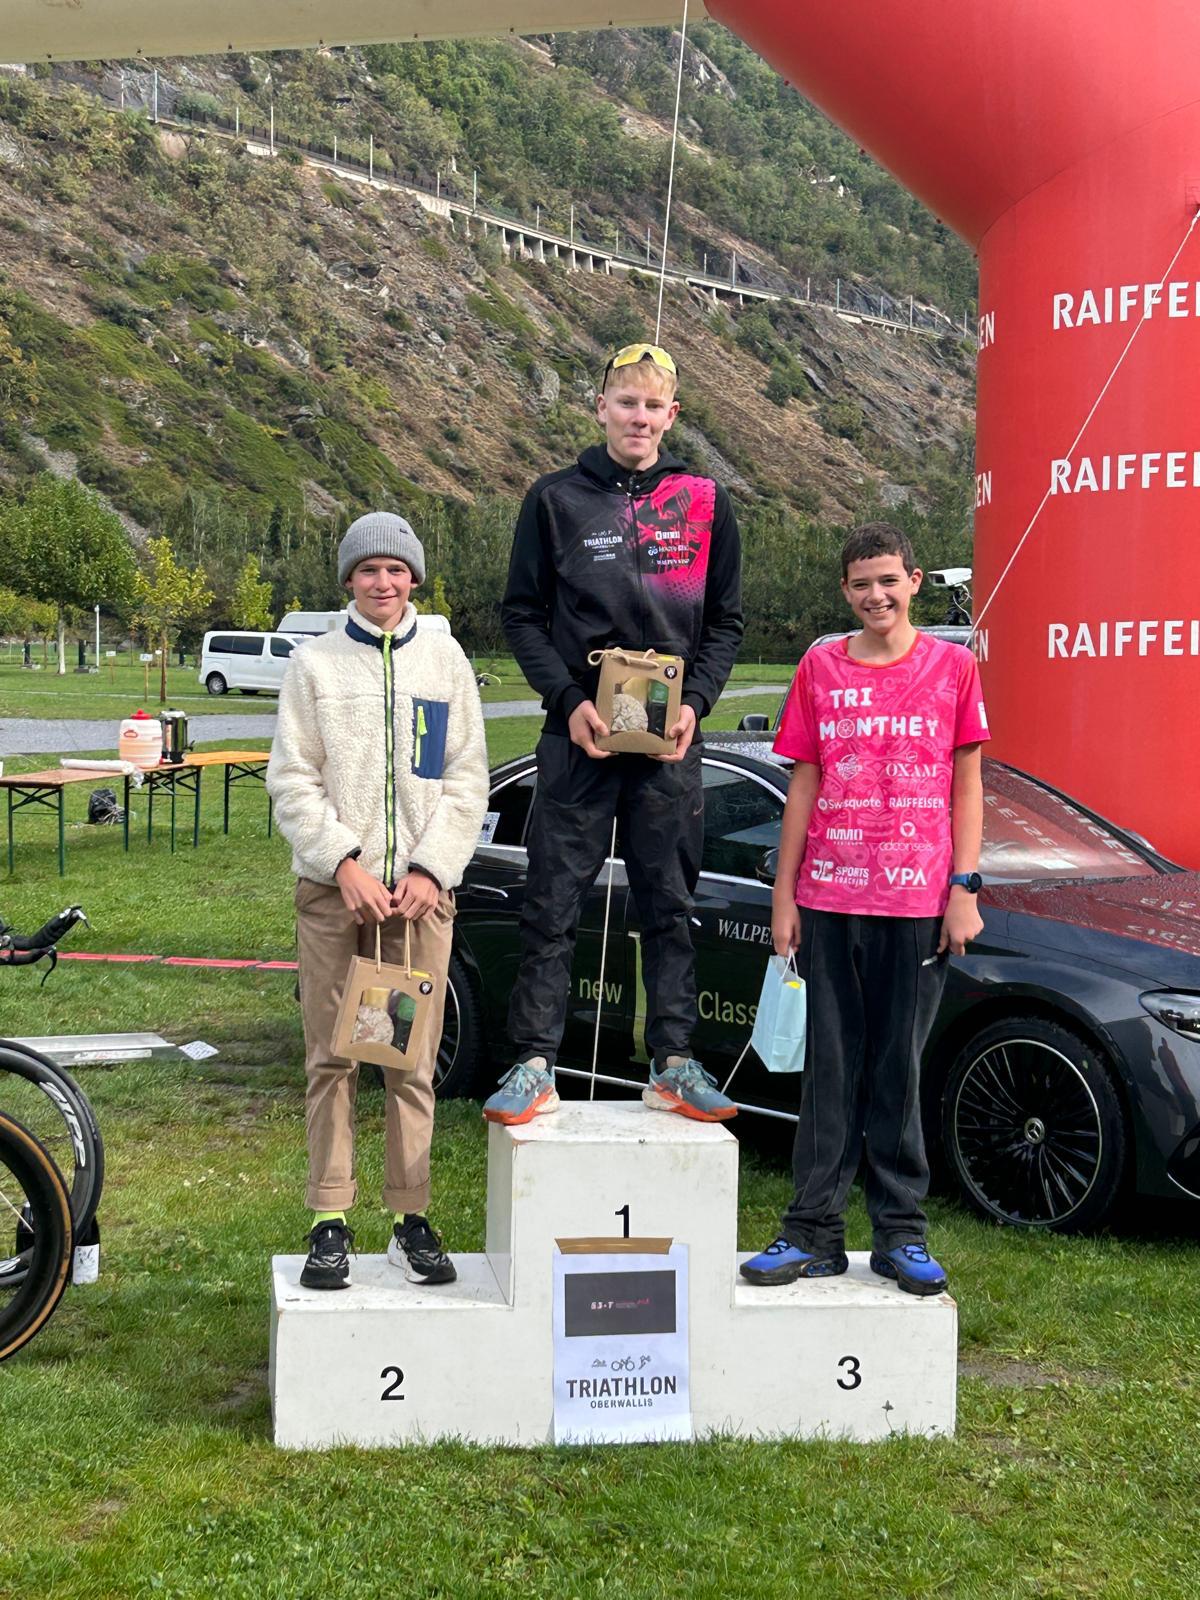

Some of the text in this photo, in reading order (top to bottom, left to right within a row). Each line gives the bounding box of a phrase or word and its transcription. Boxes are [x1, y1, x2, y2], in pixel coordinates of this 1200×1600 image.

[583, 535, 623, 547] TRIATHLON
[829, 687, 873, 709] TRI
[885, 763, 937, 778] OXAM
[889, 797, 944, 808] RAIFFEISEN
[835, 866, 869, 878] SPORTS
[884, 867, 927, 886] VPA
[718, 918, 772, 946] WALPE
[580, 978, 622, 1004] new
[698, 990, 759, 1026] Class
[614, 1204, 630, 1238] 1
[380, 1366, 405, 1401] 2
[836, 1356, 862, 1390] 3
[566, 1376, 677, 1399] TRIATHLON
[590, 1398, 653, 1409] OBERWALLIS
